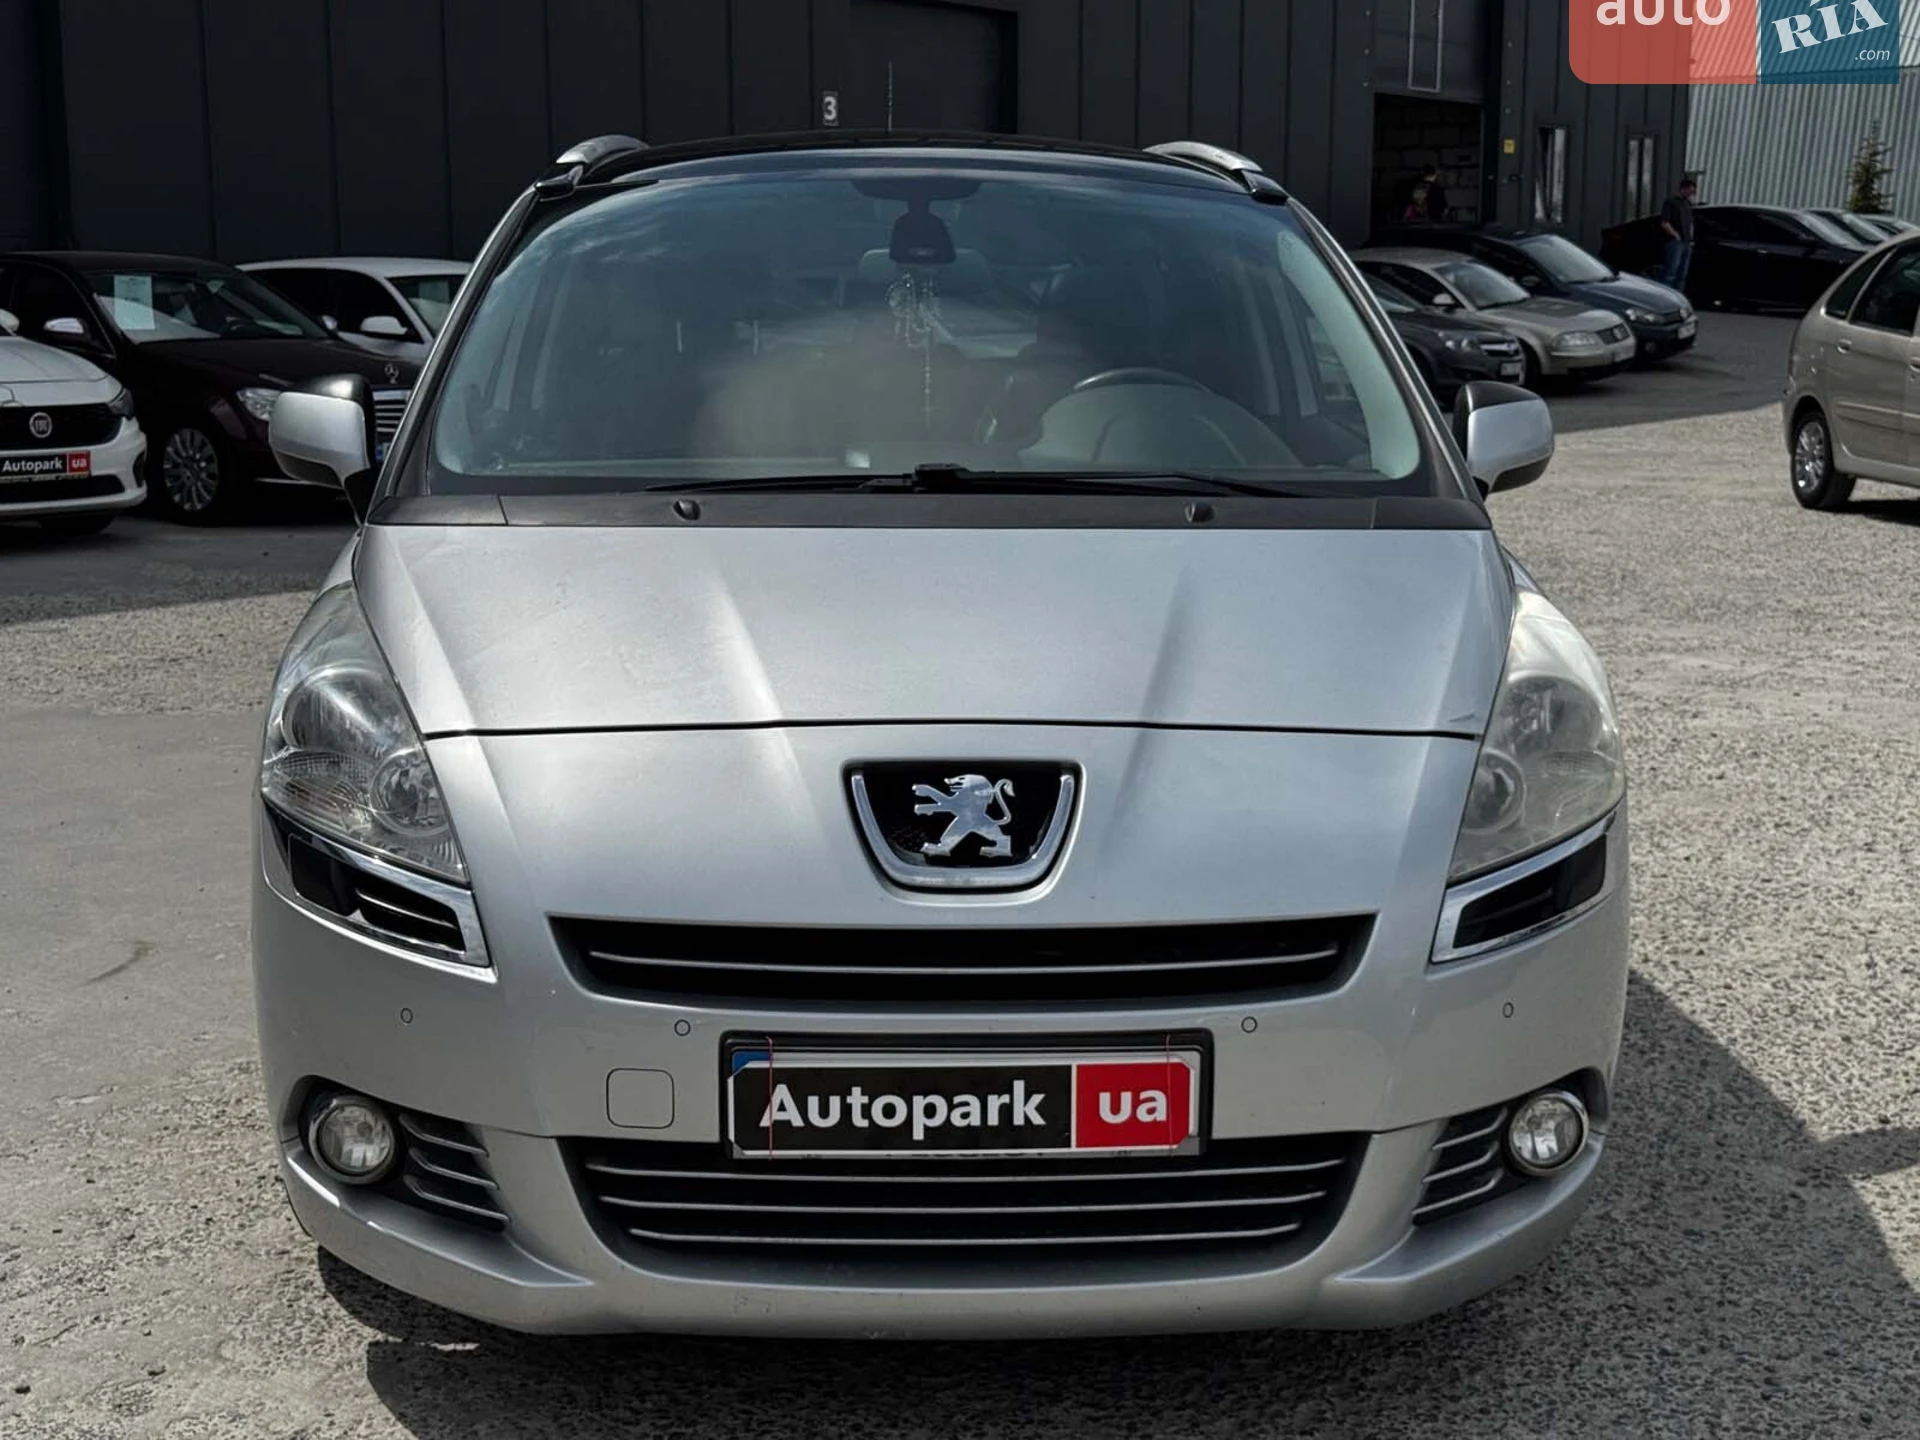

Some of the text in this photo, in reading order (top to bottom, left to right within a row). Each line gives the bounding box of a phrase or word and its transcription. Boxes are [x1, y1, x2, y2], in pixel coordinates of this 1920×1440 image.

[824, 96, 837, 120] 3
[3, 457, 87, 473] Autopark ua
[760, 1080, 1167, 1141] Autopark ua
